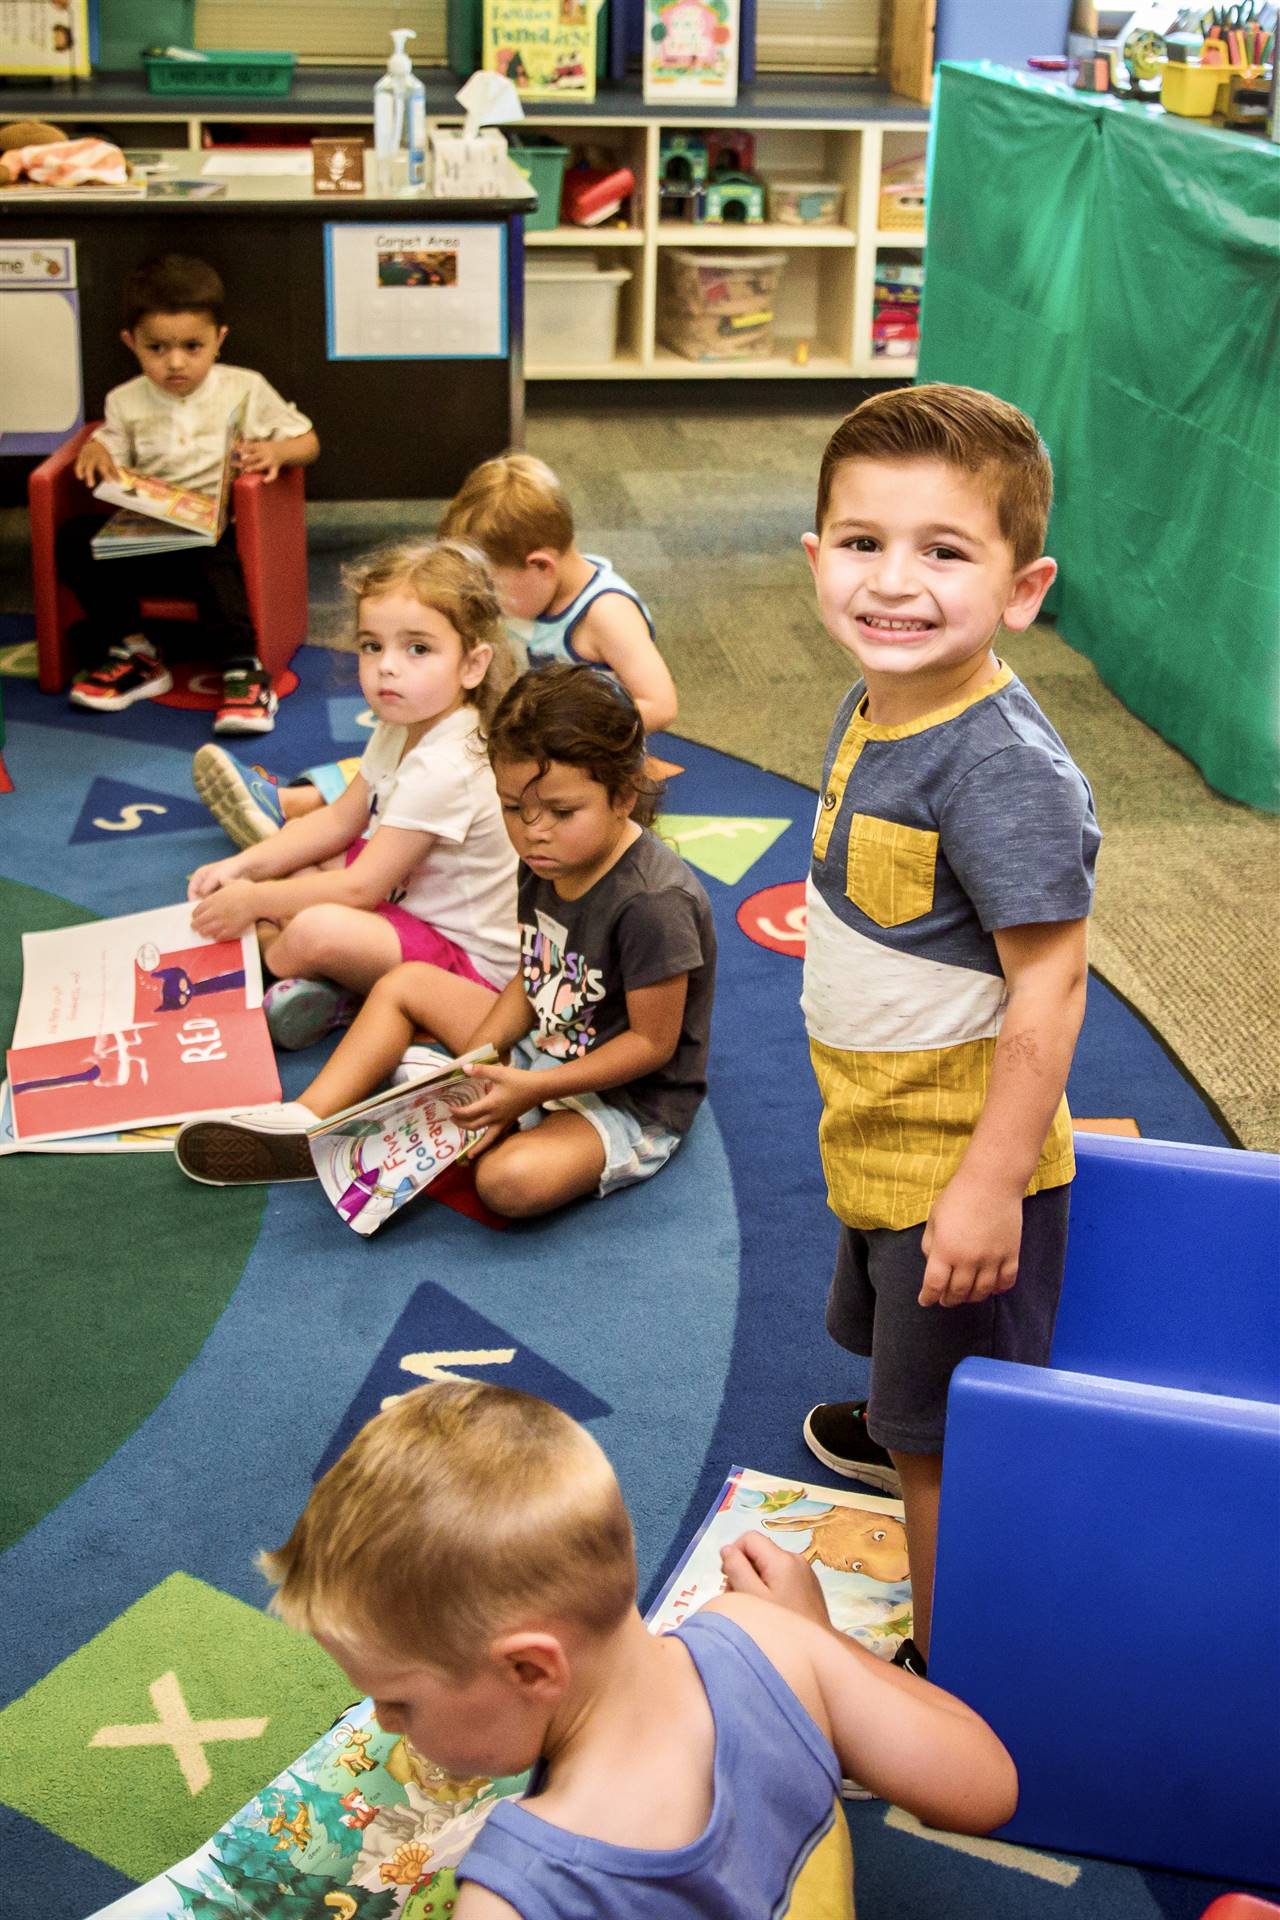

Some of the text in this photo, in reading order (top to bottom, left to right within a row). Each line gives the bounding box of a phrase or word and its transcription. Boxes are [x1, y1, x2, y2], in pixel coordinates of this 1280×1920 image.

[376, 235, 421, 249] Carpet
[176, 1016, 228, 1064] RED
[383, 1131, 407, 1171] Five
